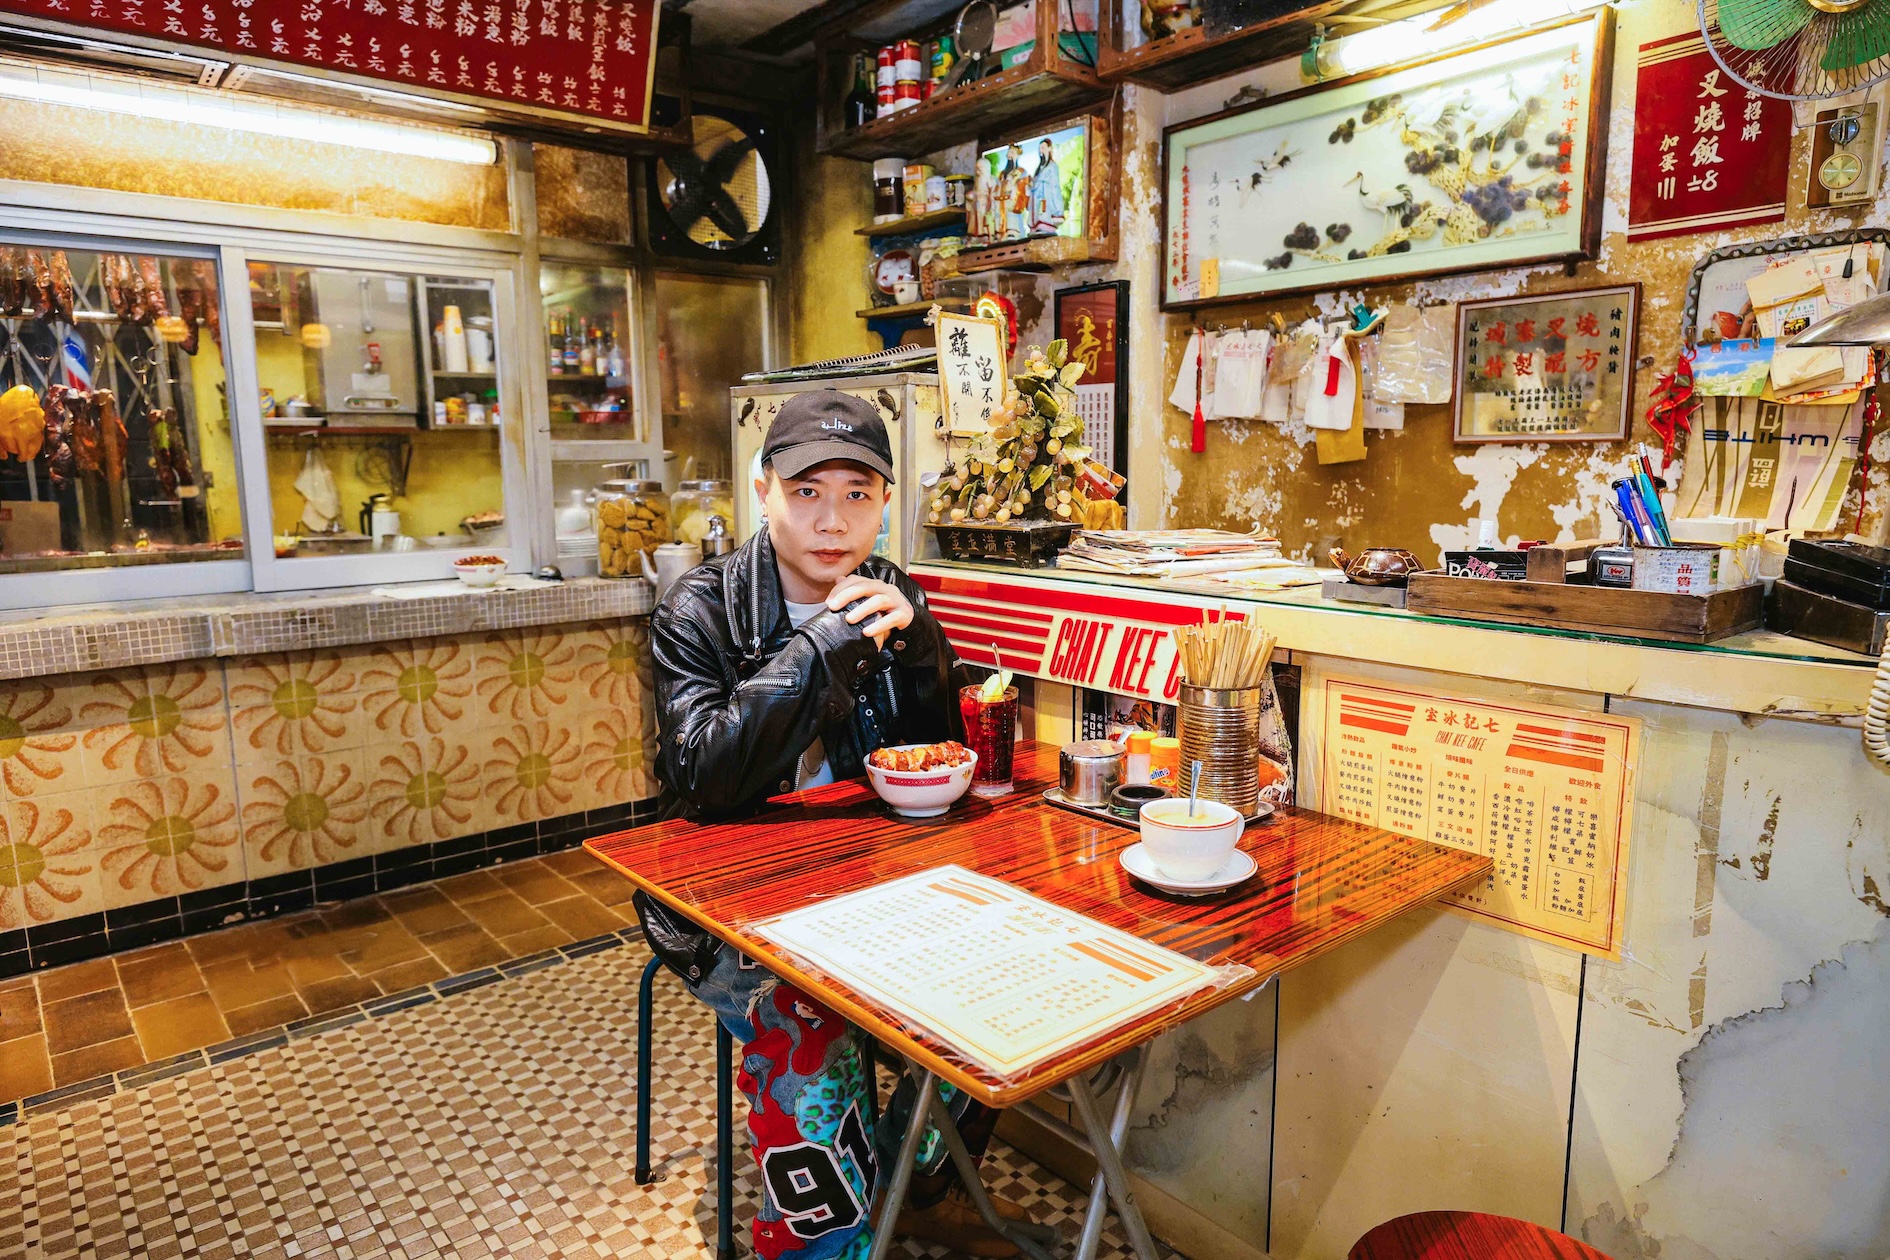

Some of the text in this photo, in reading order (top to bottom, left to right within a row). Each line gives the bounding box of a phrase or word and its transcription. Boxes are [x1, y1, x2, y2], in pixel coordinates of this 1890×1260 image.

[1690, 69, 1729, 168] 叉燒飯
[1658, 134, 1680, 173] 加蛋
[1049, 617, 1114, 684] CHAT
[1108, 626, 1168, 694] KEE
[1435, 730, 1487, 751] CHAT KEE CAFE
